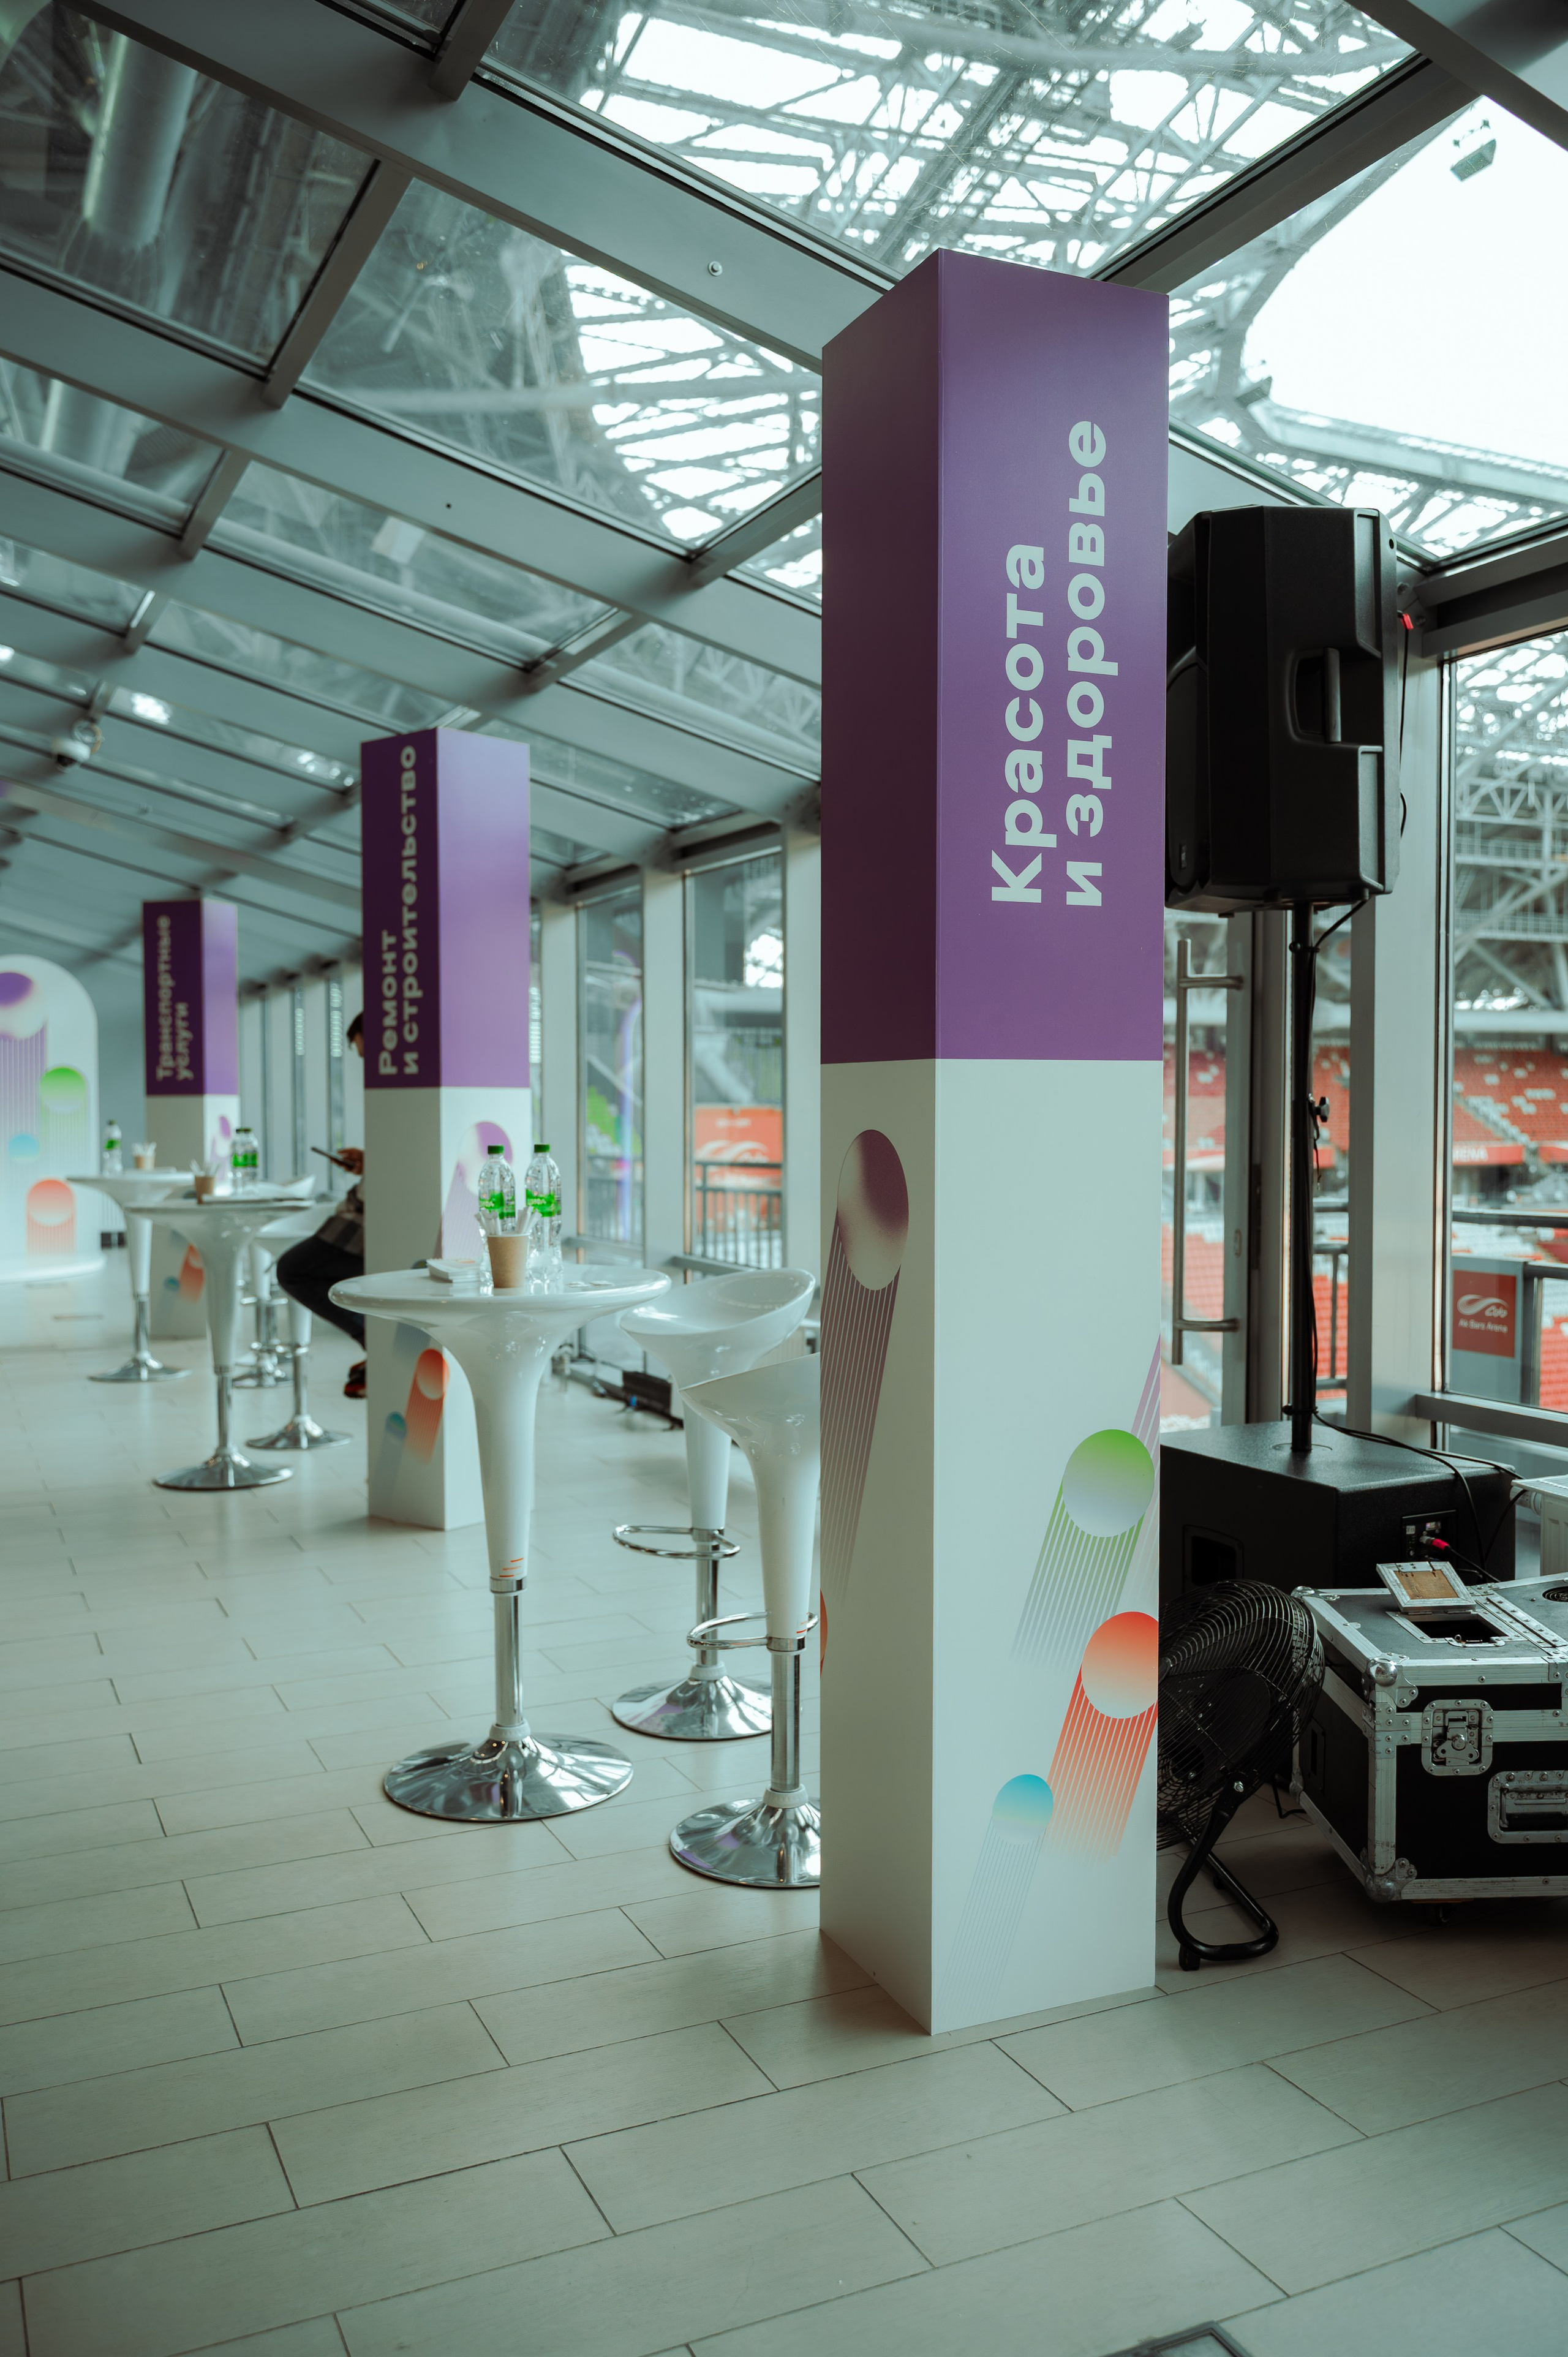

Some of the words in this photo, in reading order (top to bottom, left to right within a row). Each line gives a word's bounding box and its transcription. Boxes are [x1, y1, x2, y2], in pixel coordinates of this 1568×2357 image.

[1066, 421, 1118, 837] здоровье
[991, 544, 1057, 903] Красота
[401, 745, 423, 1044] строительство
[1066, 861, 1103, 907] и
[156, 915, 175, 1081] Транспортные
[175, 1002, 194, 1080] услуги
[379, 930, 398, 1075] Ремонт
[402, 1052, 419, 1075] и
